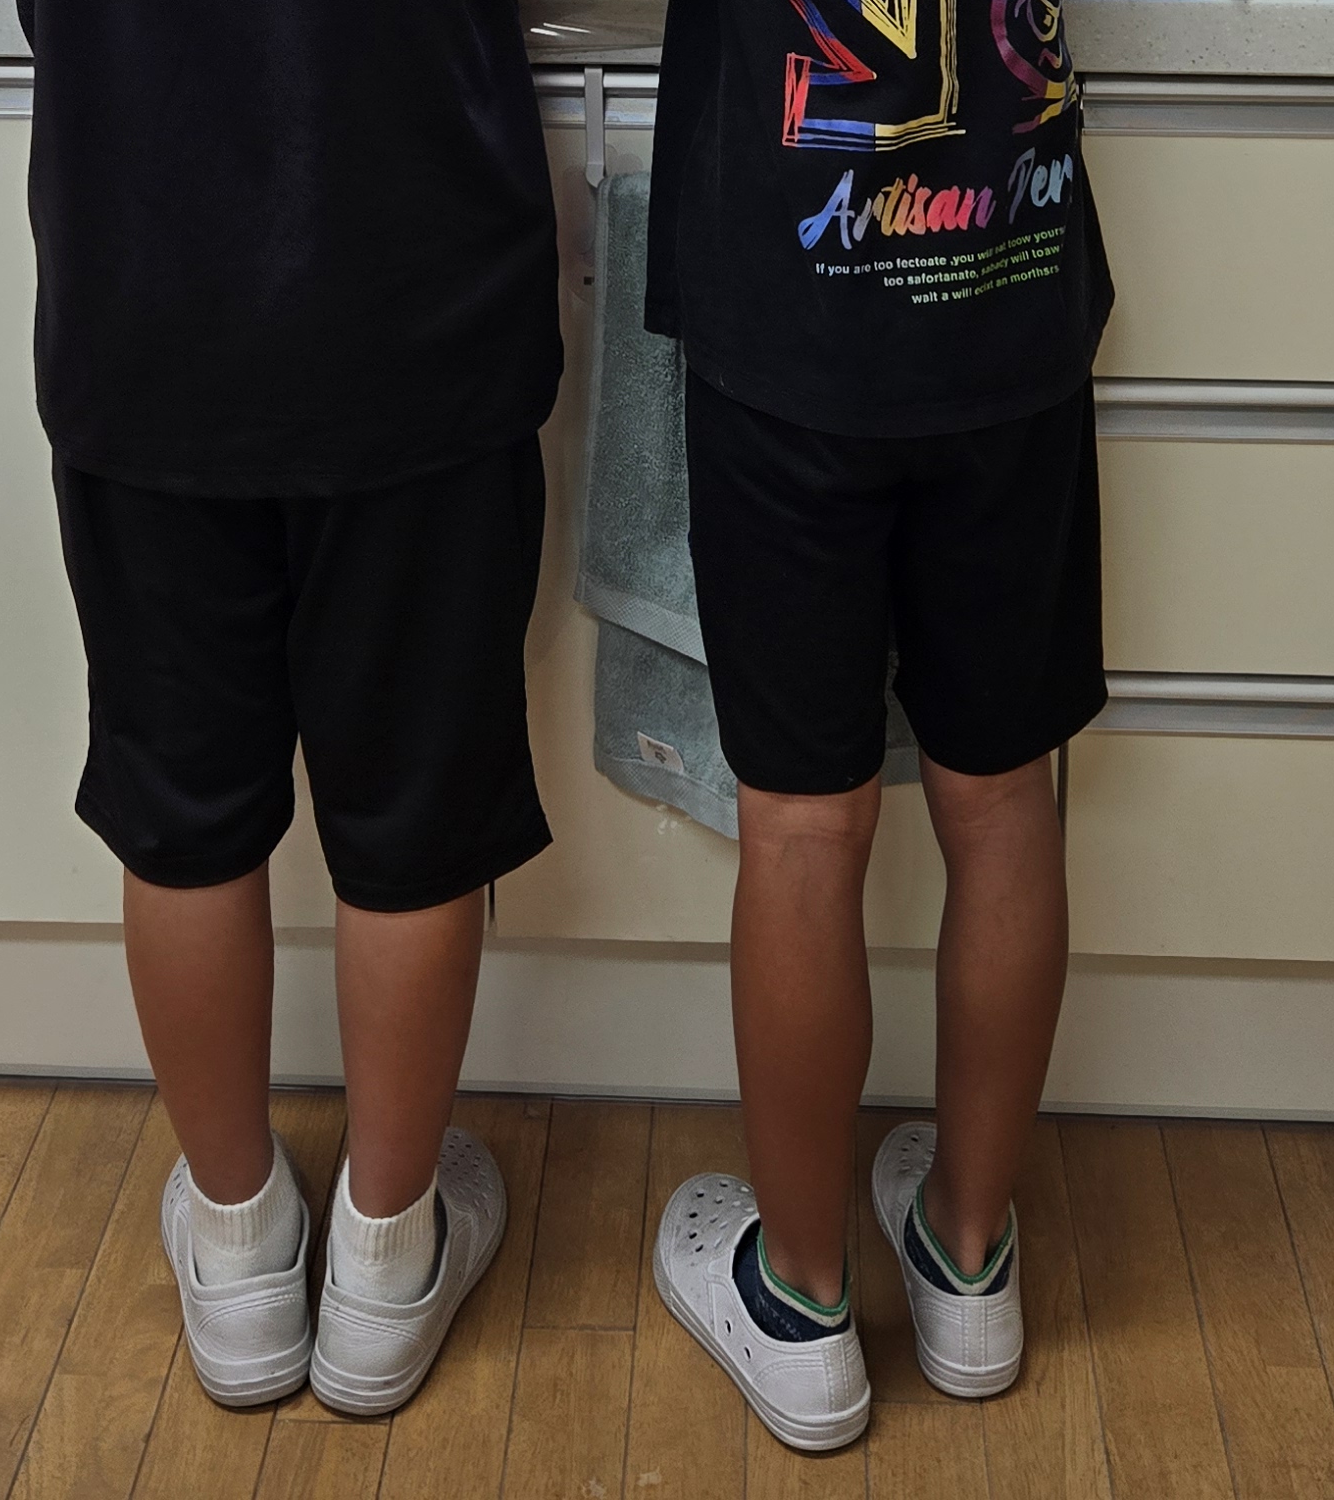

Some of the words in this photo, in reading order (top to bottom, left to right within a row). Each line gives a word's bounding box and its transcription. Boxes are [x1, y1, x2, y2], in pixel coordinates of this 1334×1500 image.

[797, 168, 997, 251] Artisan
[827, 265, 850, 277] you
[873, 261, 894, 271] too
[883, 276, 904, 287] too
[1010, 250, 1030, 264] will
[941, 292, 949, 302] a
[951, 287, 972, 300] will
